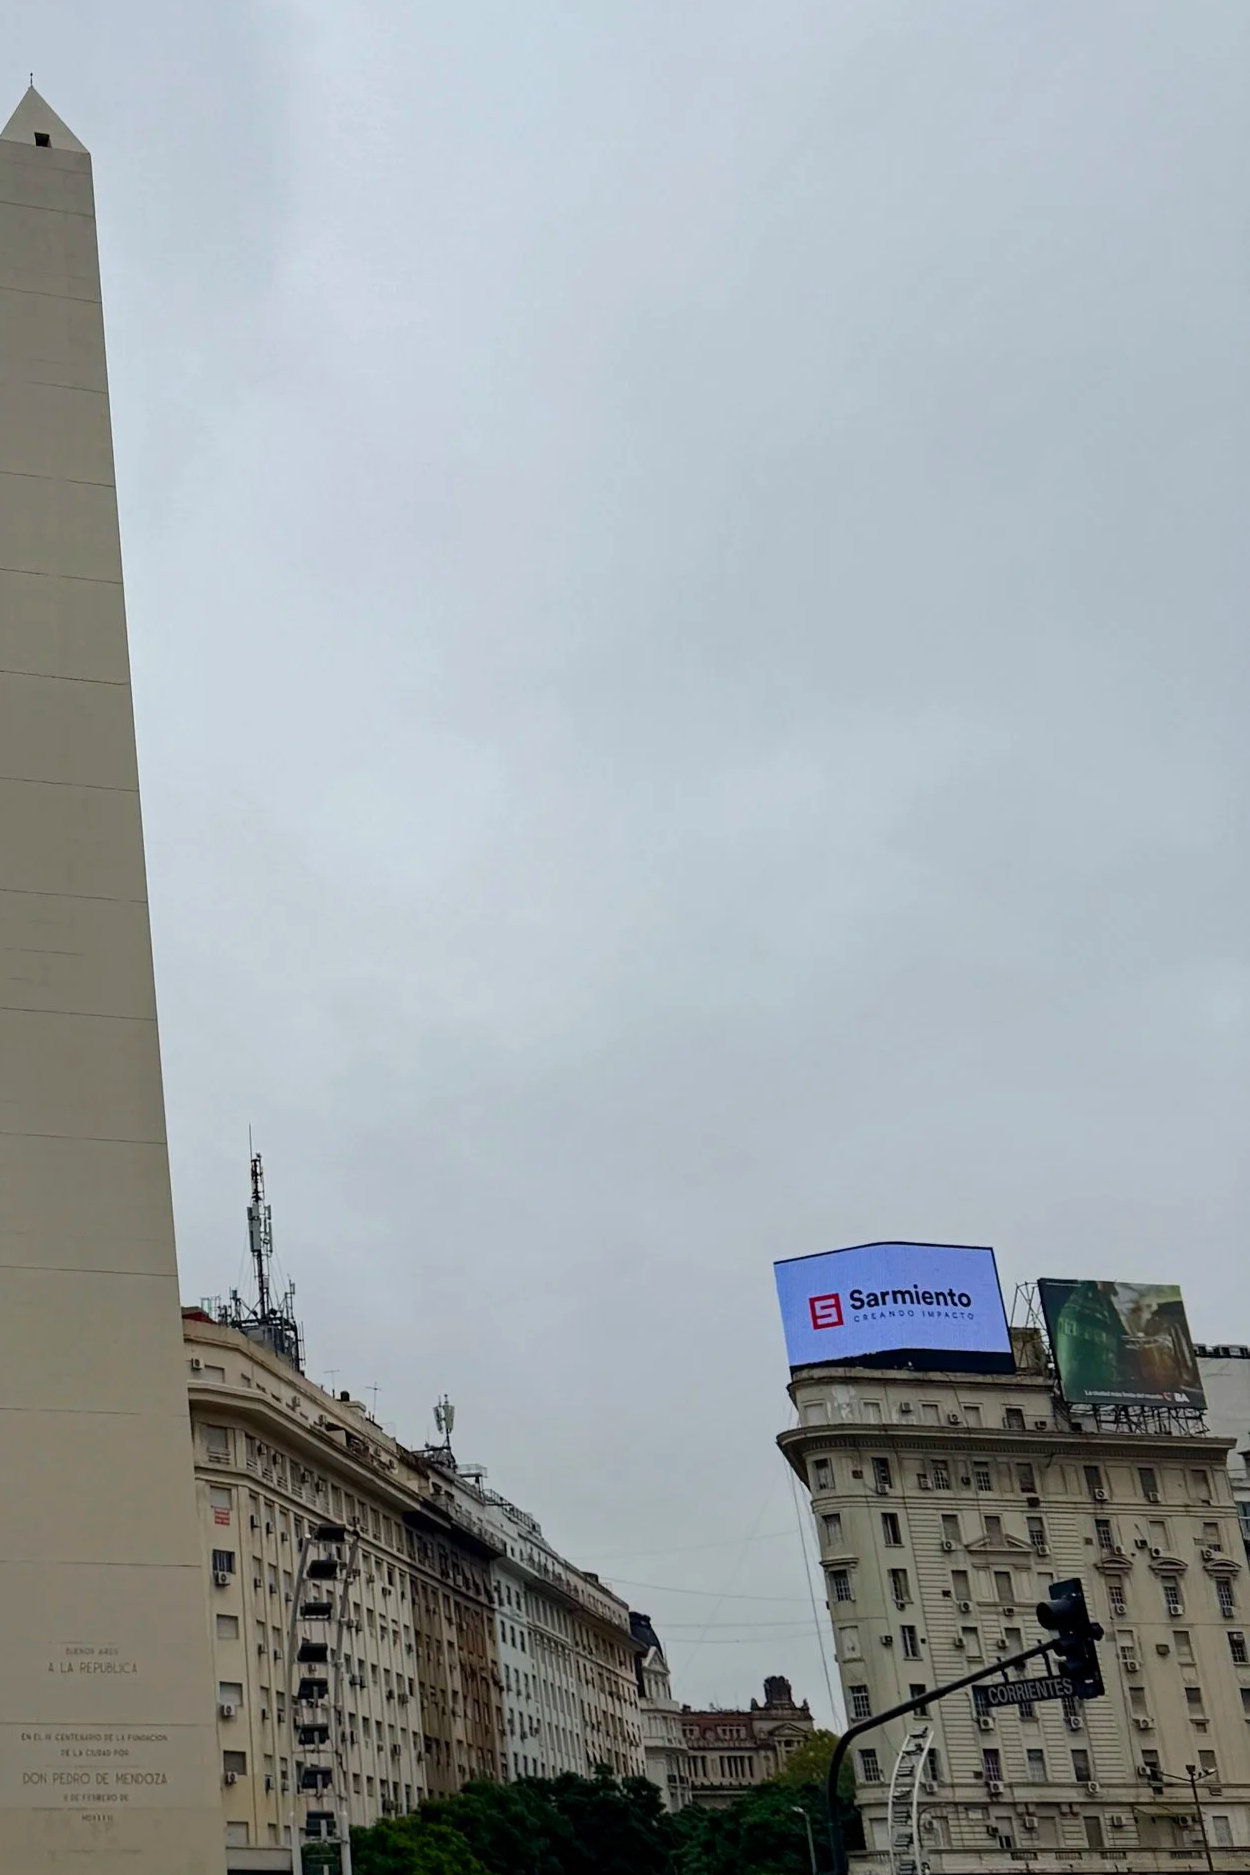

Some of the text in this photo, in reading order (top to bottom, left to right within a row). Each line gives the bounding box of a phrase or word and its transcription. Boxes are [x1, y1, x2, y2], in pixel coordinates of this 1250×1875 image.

[849, 1284, 972, 1310] Sarmiento
[853, 1310, 975, 1323] CREANDO IMPACTO
[48, 1662, 138, 1674] A LA REPUBLICA
[988, 1678, 1073, 1704] CORRIENTES
[23, 1772, 168, 1785] DON PEDRO DE MENDOZA
